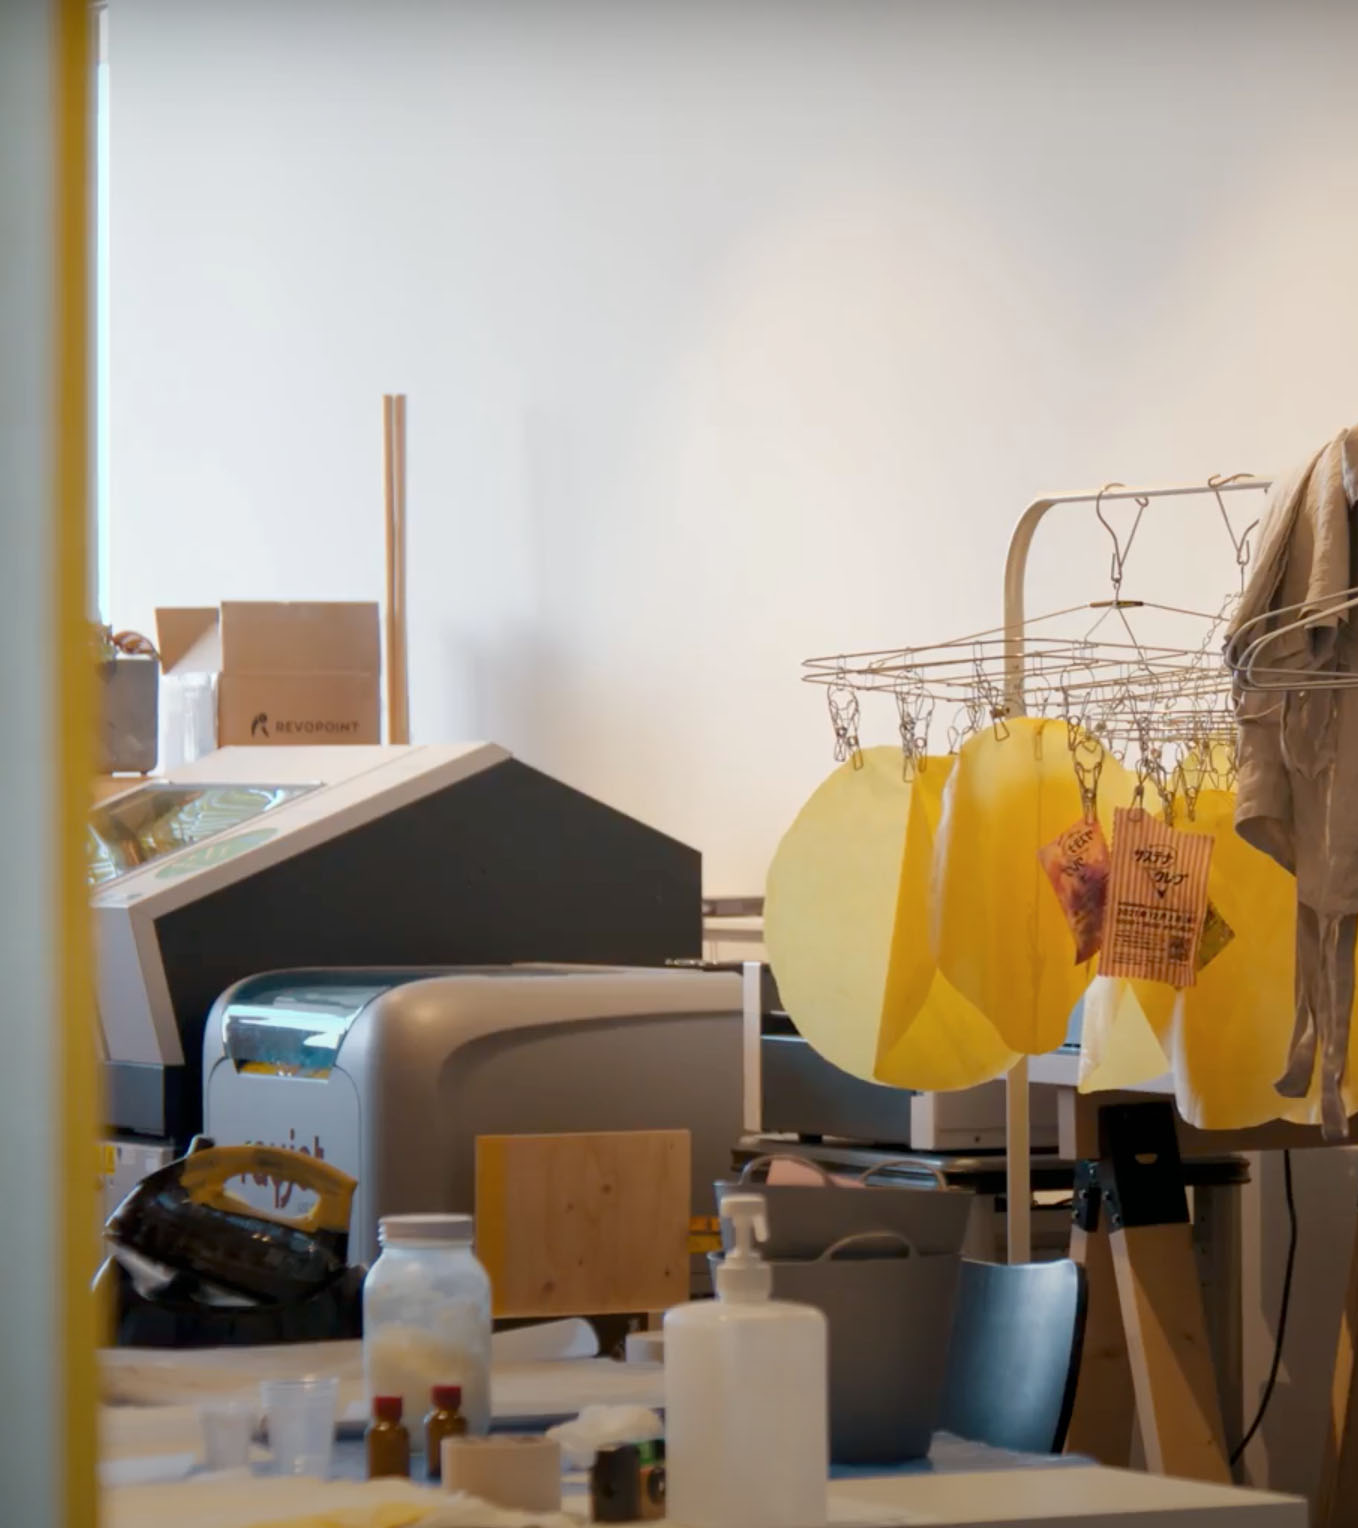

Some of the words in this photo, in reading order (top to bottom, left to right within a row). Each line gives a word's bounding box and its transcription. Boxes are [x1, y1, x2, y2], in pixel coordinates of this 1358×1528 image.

[275, 720, 360, 733] REVOPOINT
[1134, 849, 1173, 865] サステナ
